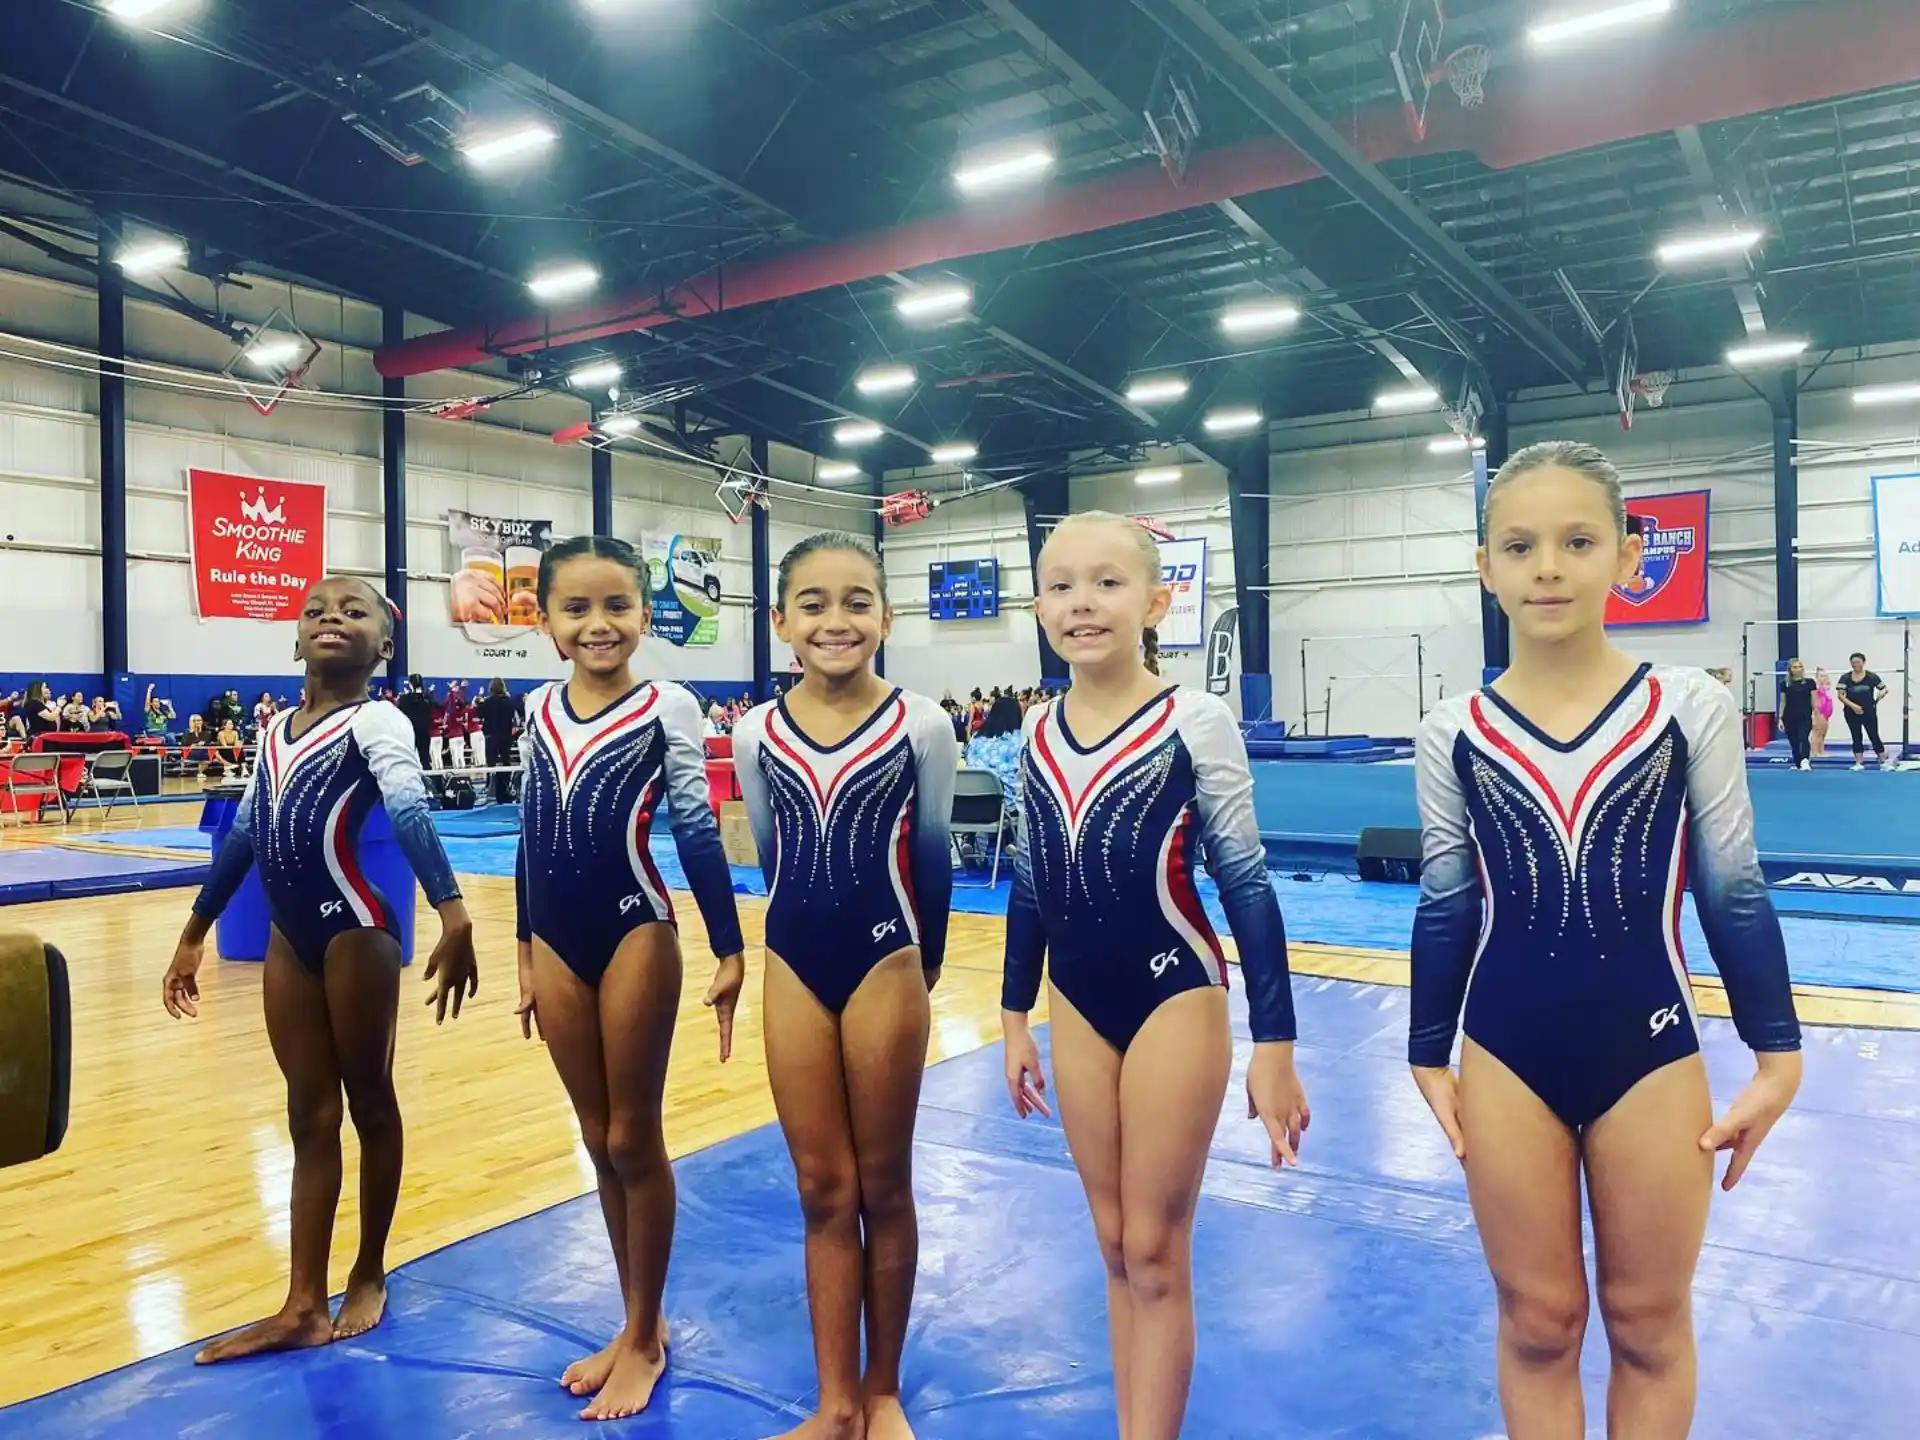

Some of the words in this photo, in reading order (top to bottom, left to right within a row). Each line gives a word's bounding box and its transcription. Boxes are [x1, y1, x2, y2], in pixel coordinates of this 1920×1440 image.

[212, 517, 307, 544] SMOOTHIE
[470, 517, 532, 536] SKYBOX
[1653, 531, 1692, 546] RANCH
[1643, 546, 1676, 555] AMPUS
[210, 568, 247, 584] Rule
[249, 571, 277, 586] the
[280, 573, 308, 591] Day
[483, 649, 512, 658] COURT
[1157, 651, 1179, 659] OURT
